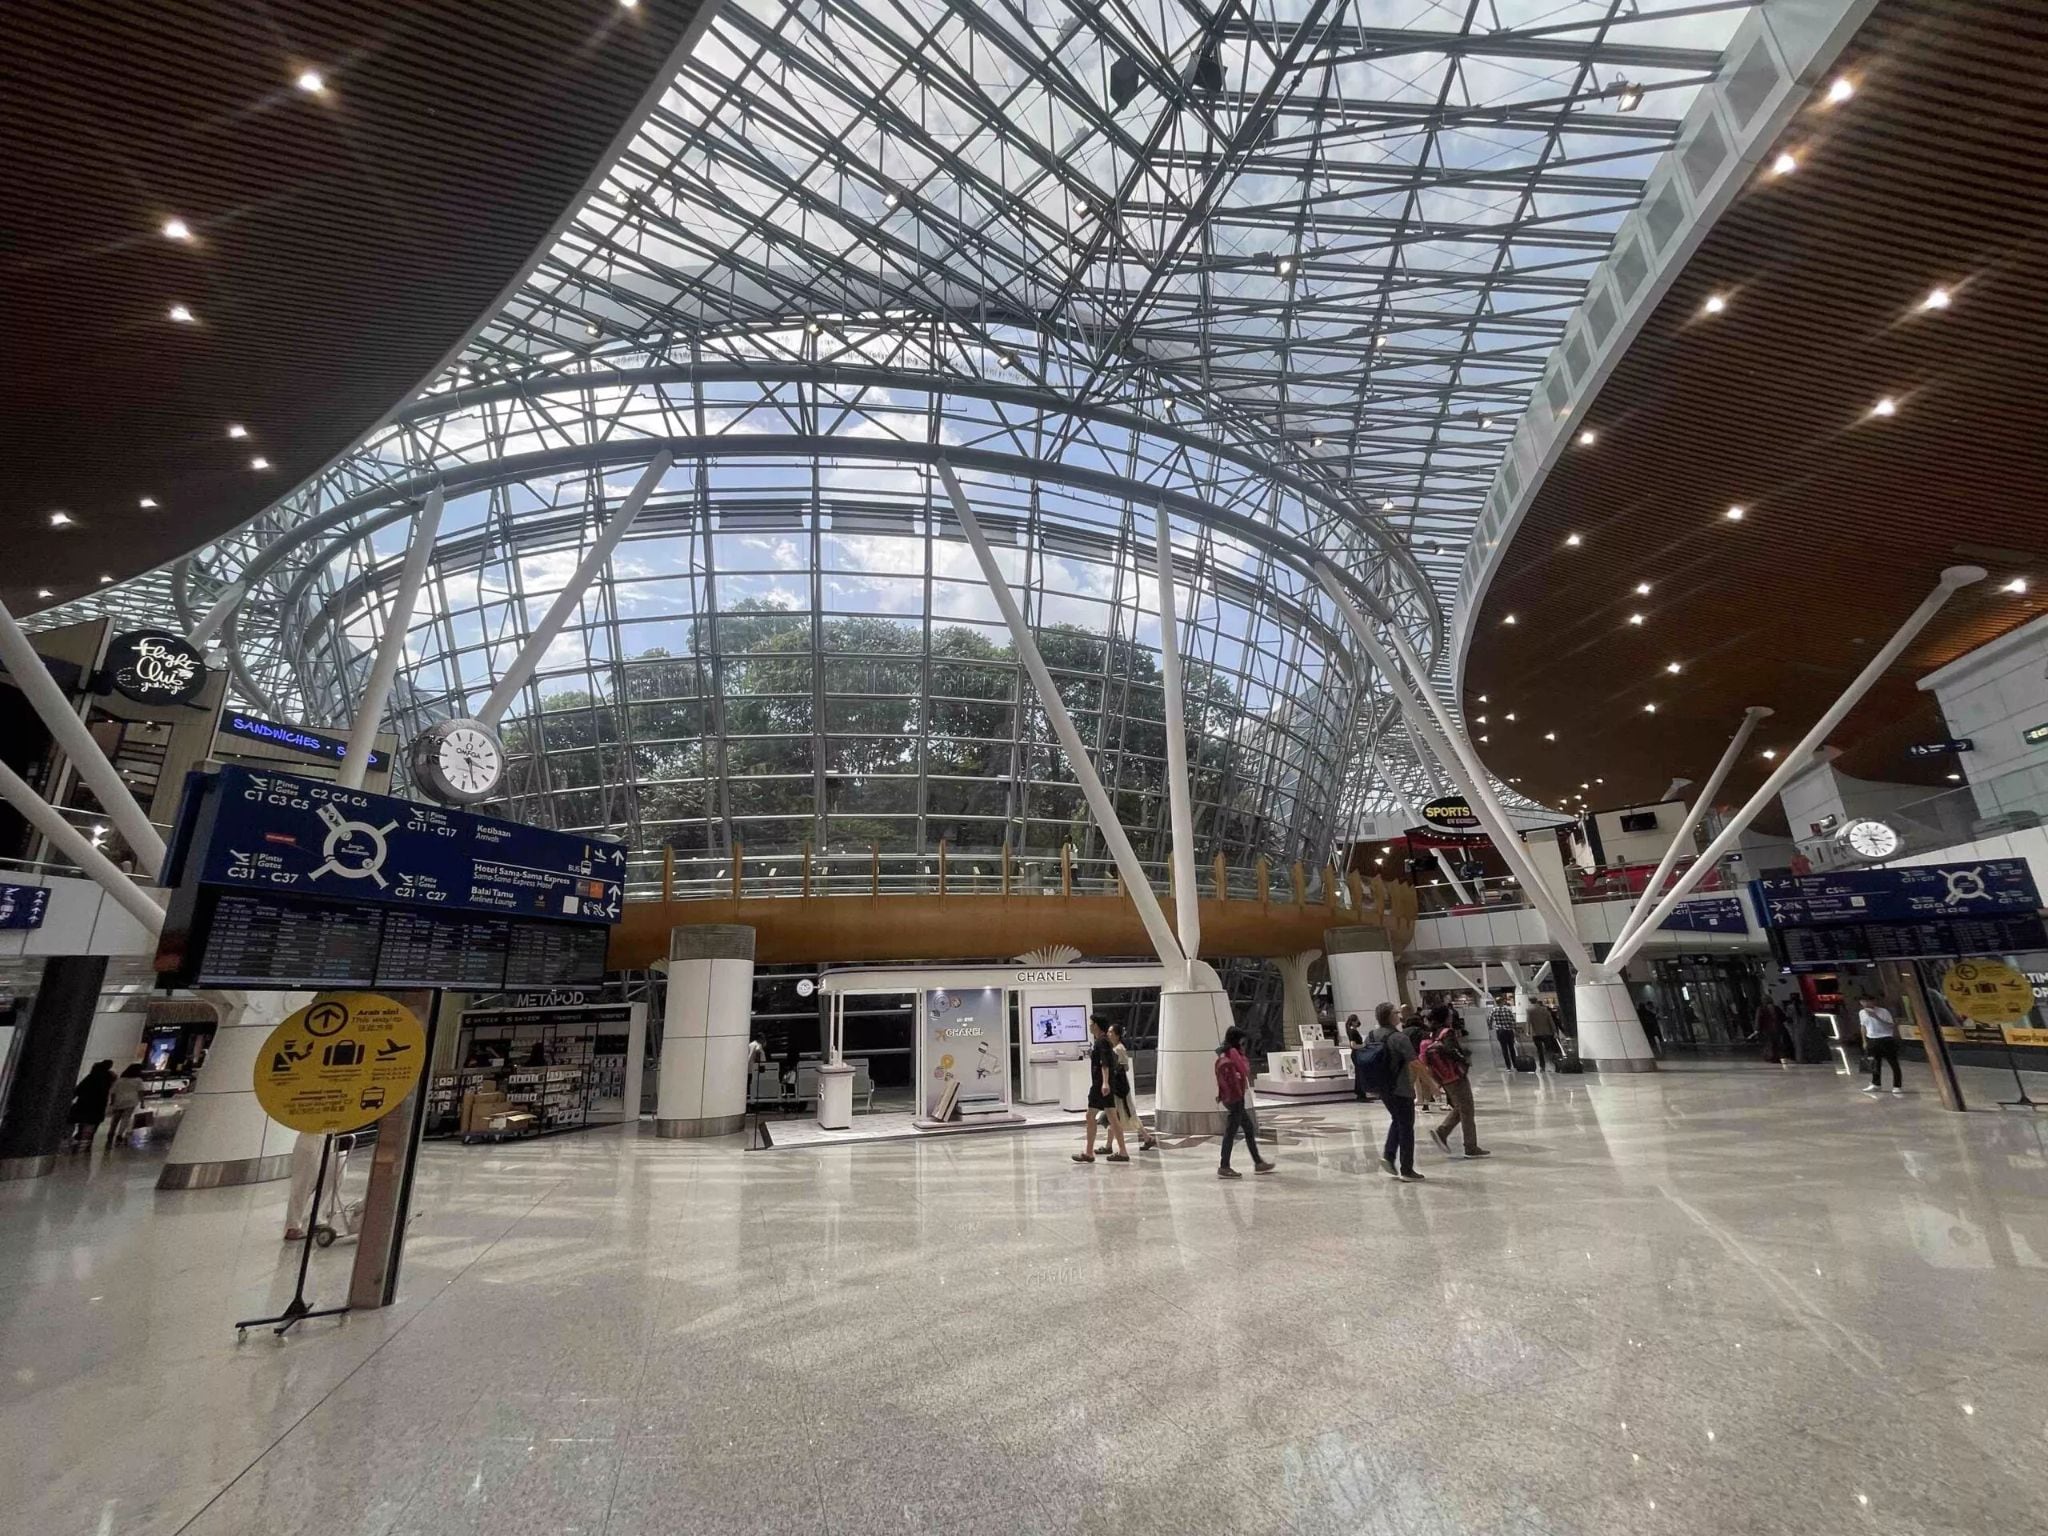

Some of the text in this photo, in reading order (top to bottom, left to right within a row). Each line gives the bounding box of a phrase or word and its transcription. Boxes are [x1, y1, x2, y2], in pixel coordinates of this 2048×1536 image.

[131, 637, 200, 671] Flight
[233, 718, 320, 749] SANDWICHES
[456, 747, 481, 759] OMEGA
[275, 786, 298, 796] Gates
[276, 779, 299, 790] Pintu
[244, 790, 310, 810] C1 C3 C5
[310, 788, 368, 808] C2 C4 C6
[430, 811, 447, 820] Pintu
[1425, 806, 1470, 817] SPORTS
[407, 821, 427, 832] C11
[437, 827, 457, 838] C17
[476, 825, 511, 838] Ketibaan
[475, 833, 499, 843] Arrivals
[258, 853, 283, 863] Pintu
[257, 860, 282, 870] Gates
[568, 864, 580, 873] BUS
[227, 867, 255, 879] C31
[270, 872, 299, 884] C37
[474, 863, 570, 885] Hotel Sama-Sama Express
[395, 887, 415, 898] C21
[426, 891, 447, 901] C27
[471, 886, 514, 899] Balai Tamu
[469, 894, 517, 908] Airlines Lounge
[1017, 971, 1071, 982] CHANEL
[517, 990, 584, 1007] METAPOD
[945, 1027, 984, 1037] CHANEL
